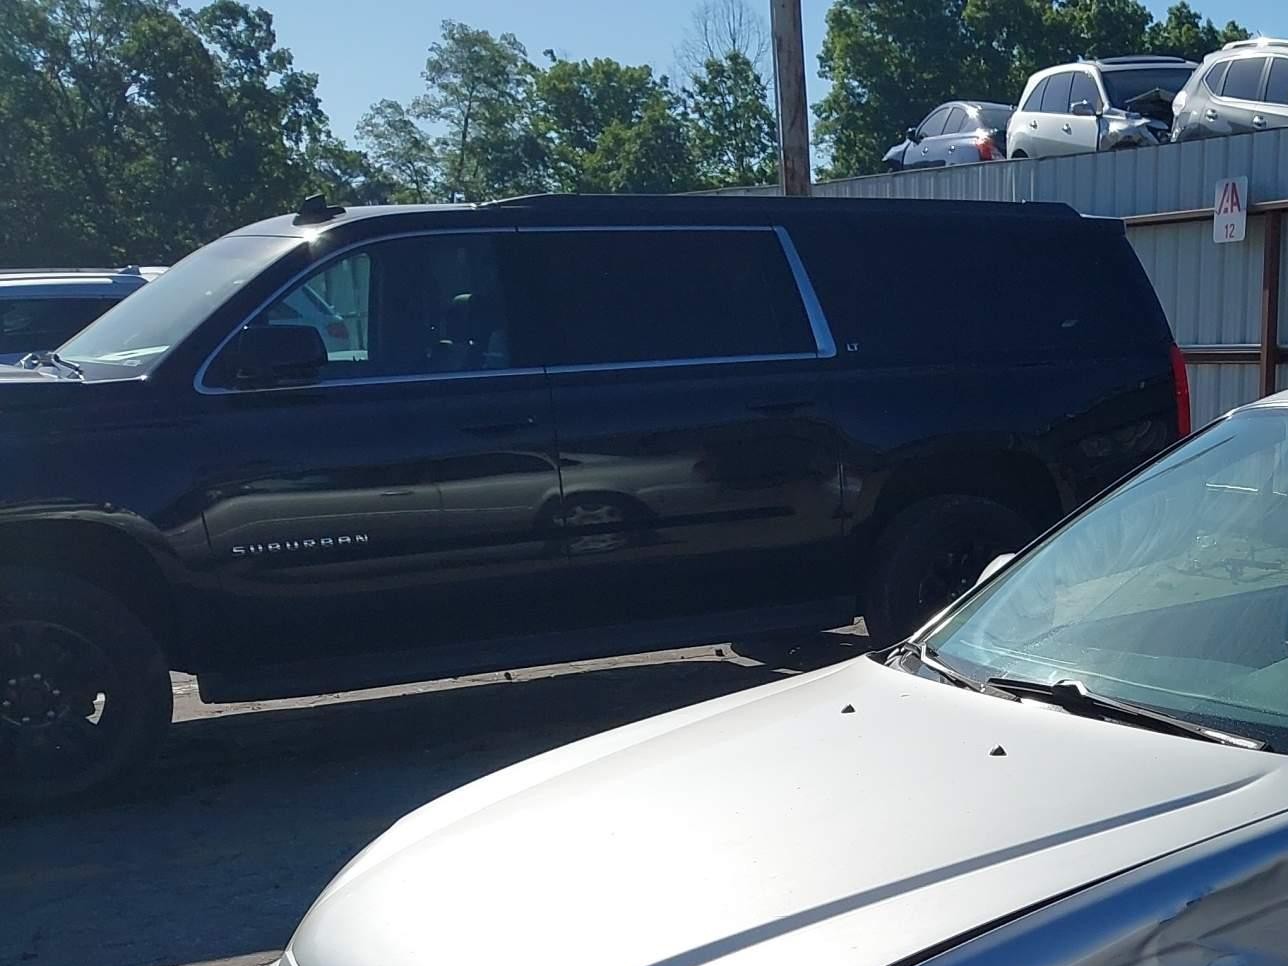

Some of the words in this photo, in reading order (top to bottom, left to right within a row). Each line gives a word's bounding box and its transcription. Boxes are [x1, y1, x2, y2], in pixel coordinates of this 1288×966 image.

[1224, 223, 1236, 239] 12
[846, 343, 859, 352] LT
[232, 533, 369, 555] SUBURBAN
